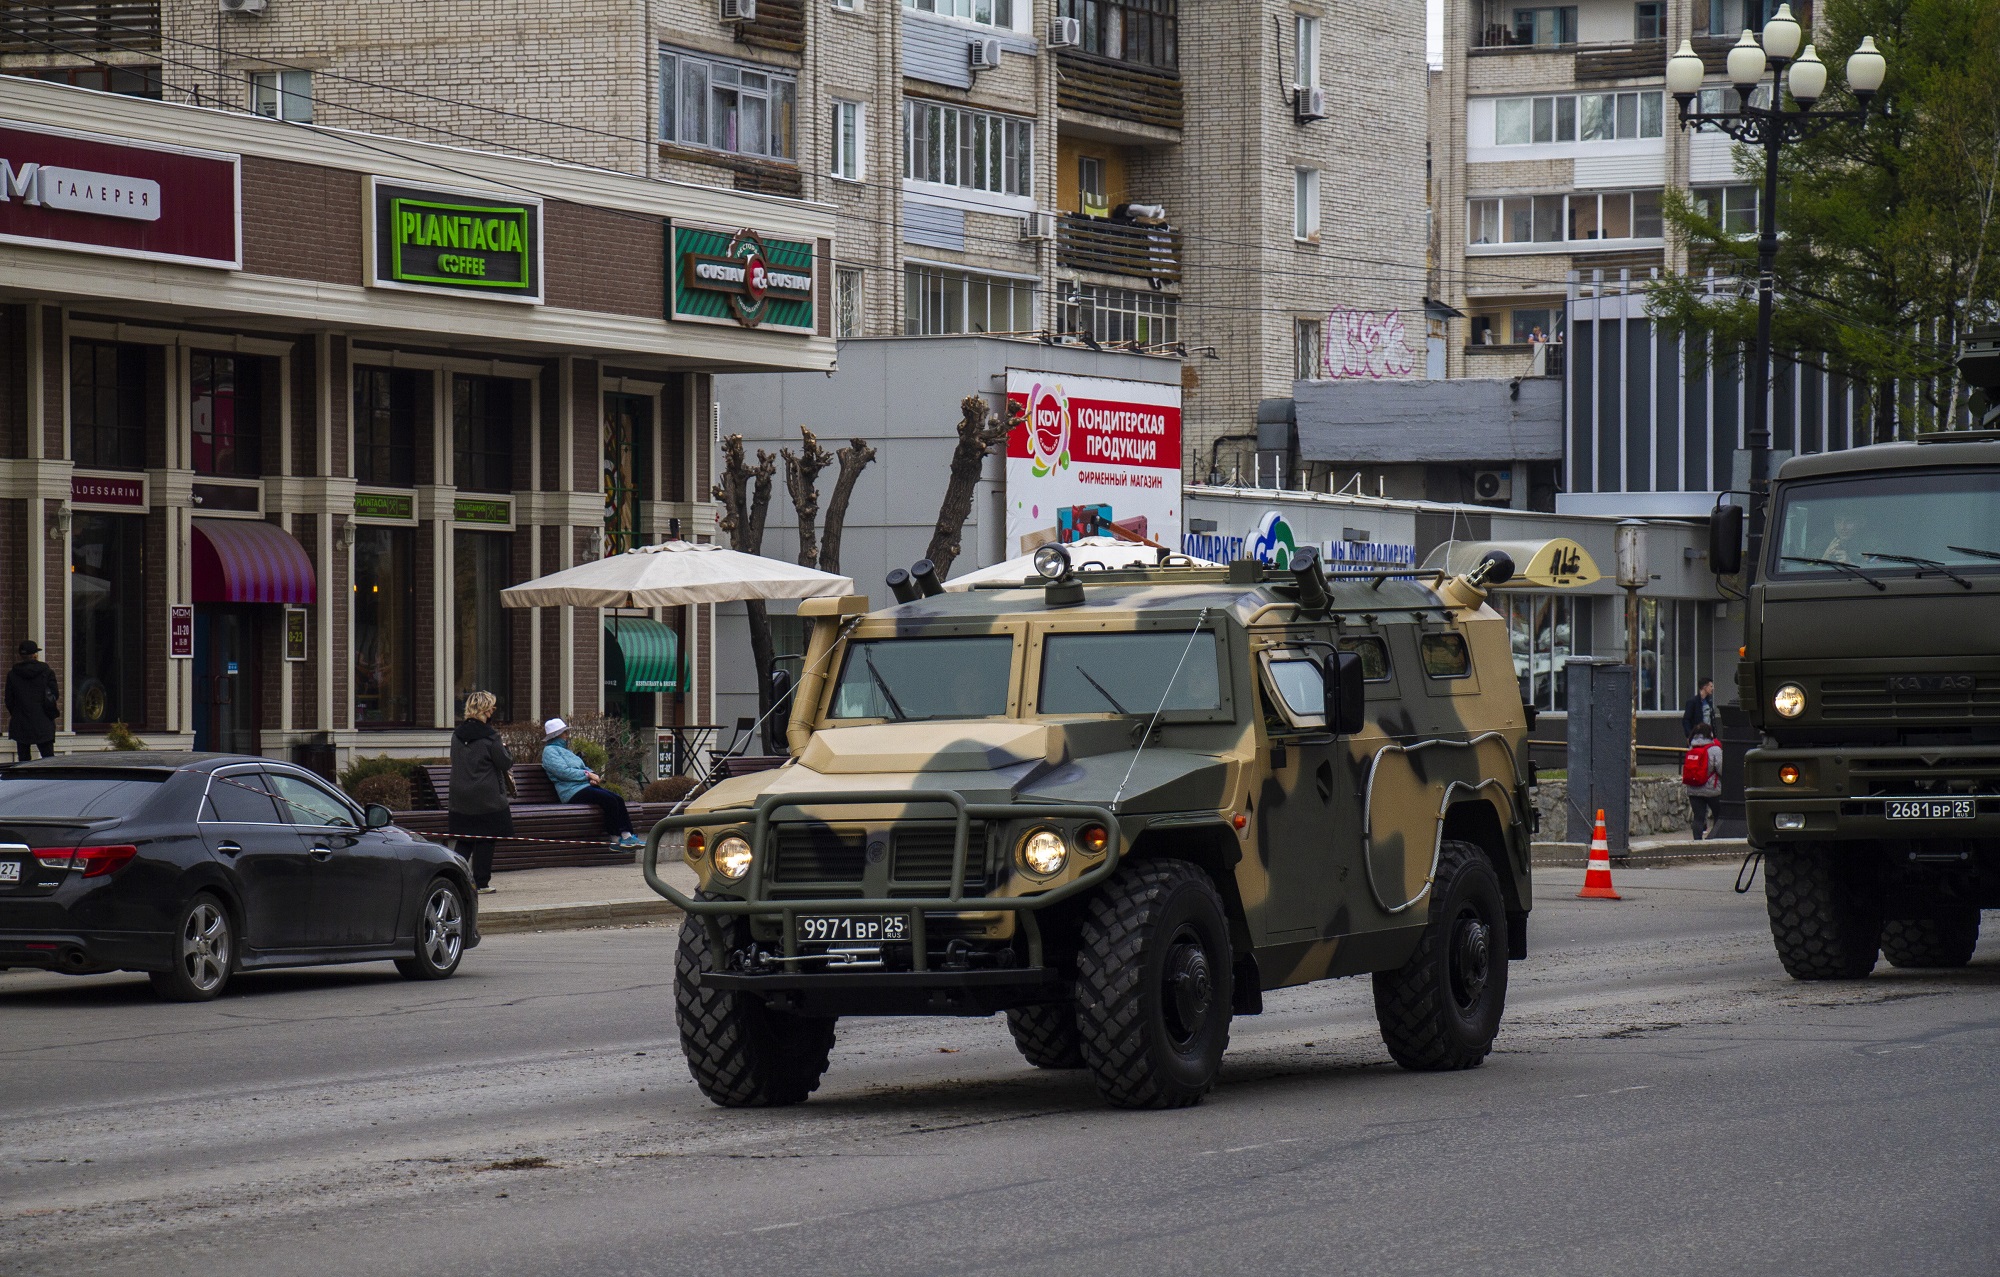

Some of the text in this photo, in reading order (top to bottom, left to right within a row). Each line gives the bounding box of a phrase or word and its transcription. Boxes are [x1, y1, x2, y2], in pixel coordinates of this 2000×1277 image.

[57, 180, 148, 206] ГАЛЕРЕЯ
[401, 211, 522, 252] PLANTACIA
[438, 254, 486, 275] COFFEE
[696, 263, 811, 291] GUSTAV & GUSTAV
[1037, 409, 1060, 427] KDV
[1077, 408, 1165, 435] КОНДИТЕРСКАЯ
[1086, 435, 1156, 463] ПРОДУКЦИЯ
[1078, 470, 1162, 489] ФИРМЕННЫЙ МАГАЗИН
[1331, 541, 1415, 564] МЫ КОНТРОЛИРУЕМ
[1955, 802, 1970, 812] 25
[1, 863, 16, 875] 27
[884, 917, 904, 932] 25
